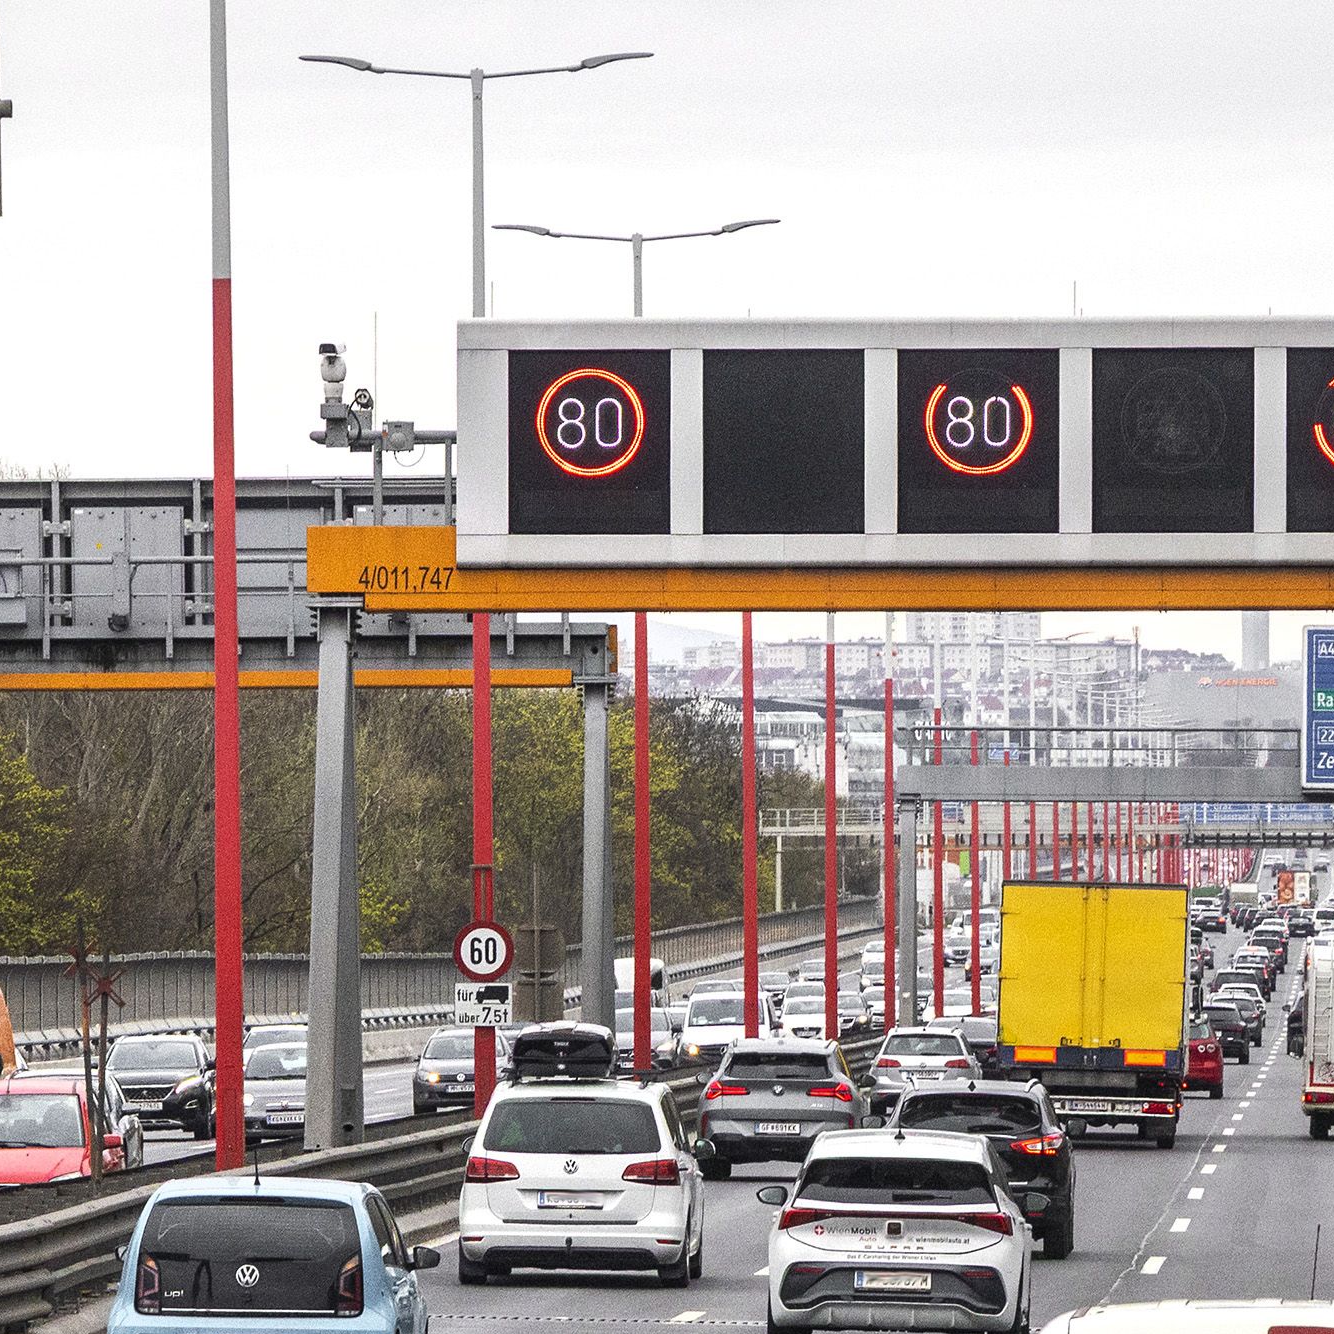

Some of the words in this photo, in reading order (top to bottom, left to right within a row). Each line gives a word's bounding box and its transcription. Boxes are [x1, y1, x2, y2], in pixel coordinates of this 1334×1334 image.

[557, 397, 623, 449] 80
[946, 395, 1011, 447] 80
[358, 565, 455, 594] 4/011,747
[470, 937, 497, 965] 60
[457, 989, 473, 1001] für
[459, 1011, 481, 1023] über
[164, 1290, 184, 1298] up!
